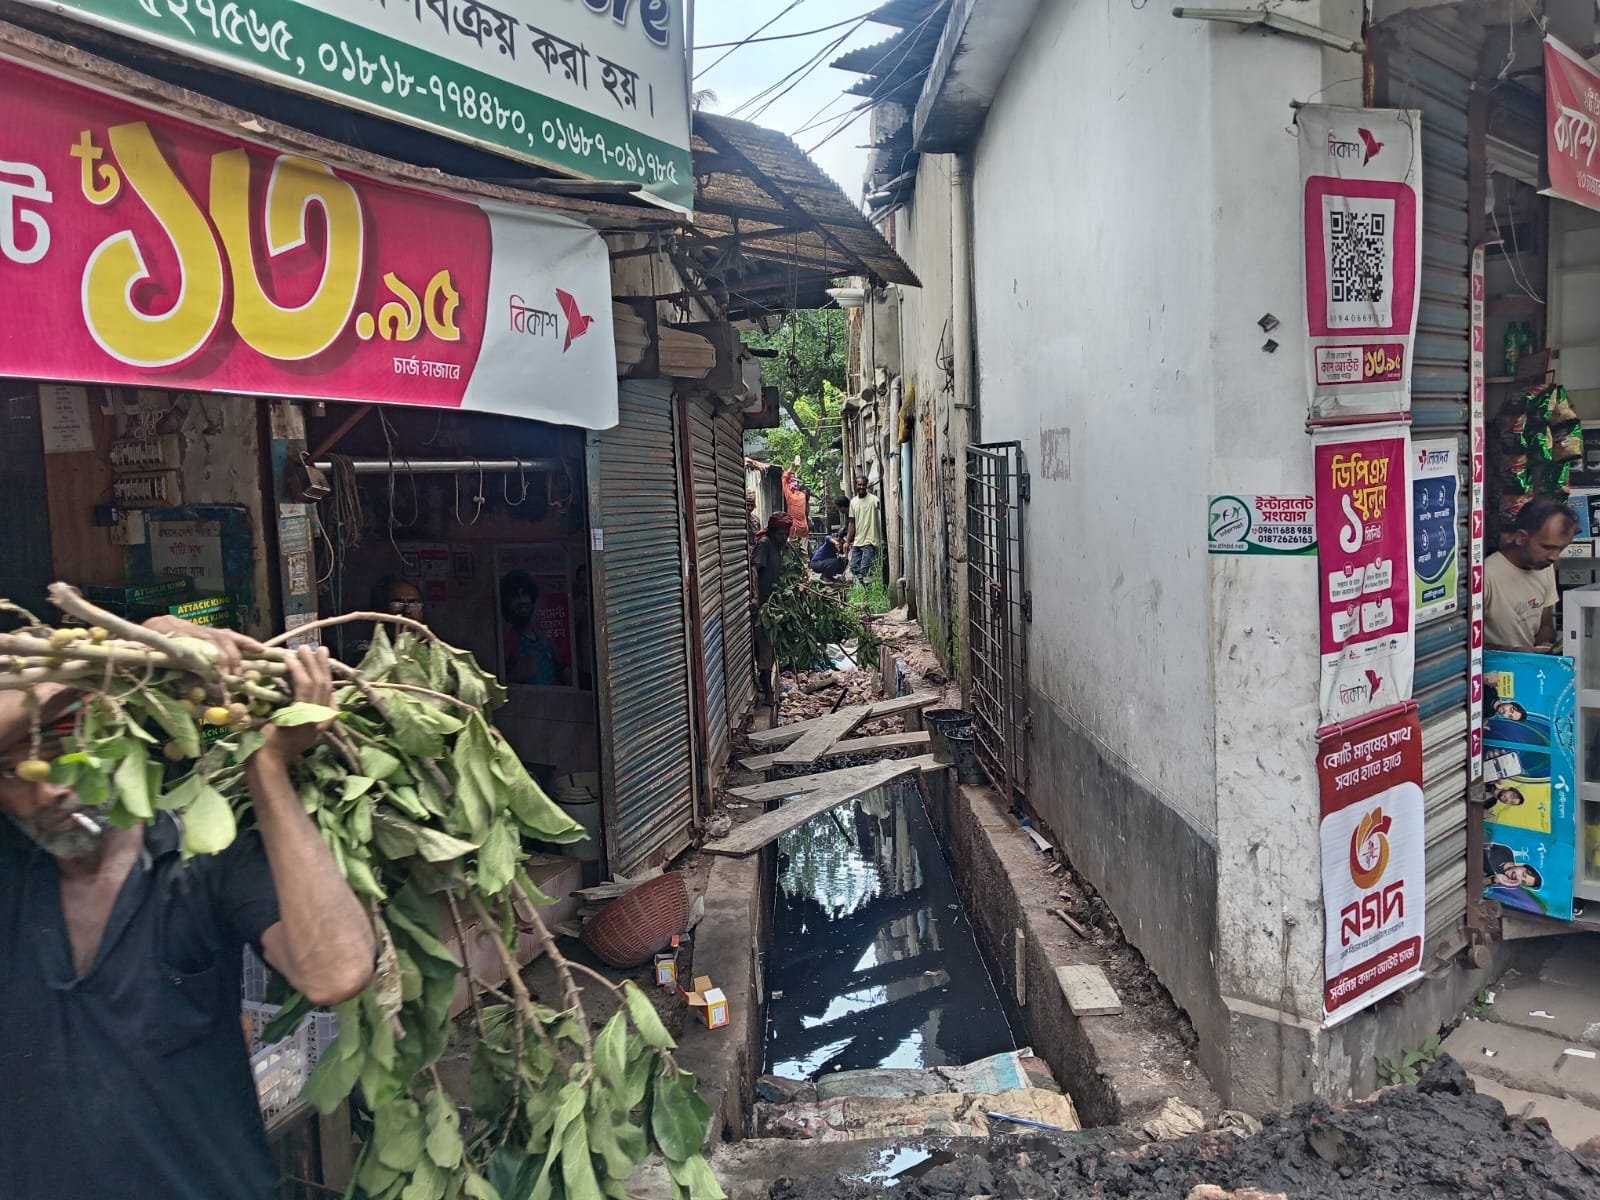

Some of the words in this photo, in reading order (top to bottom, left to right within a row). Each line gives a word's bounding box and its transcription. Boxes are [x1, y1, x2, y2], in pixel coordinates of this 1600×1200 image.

[526, 23, 590, 91] করা
[596, 55, 640, 110] হয়
[1327, 131, 1360, 159] বিকাশ
[509, 293, 559, 340] বিকাশ
[393, 354, 420, 377] চার্জ
[421, 360, 461, 381] হাজারে
[1331, 452, 1389, 490] ডিপিএস
[1255, 495, 1314, 511] ইন্টারনেট
[1262, 511, 1307, 523] সংযোগ
[1352, 485, 1388, 521] খুলুন
[1258, 526, 1279, 535] 09611
[1280, 526, 1296, 535] 688
[1297, 526, 1313, 535] 988
[1258, 535, 1314, 544] 01872626163
[1340, 494, 1364, 554] ১
[177, 599, 211, 615] ATTACK
[210, 596, 231, 606] KING
[188, 613, 210, 625] TACK
[1339, 683, 1368, 705] বিকাশ
[1323, 741, 1353, 769] কোটি
[1353, 733, 1389, 761] মানুষের
[1388, 726, 1412, 747] সাথে
[1335, 768, 1360, 791] সবার
[1360, 759, 1382, 781] হাতে
[1382, 751, 1402, 772] হাতে
[1340, 879, 1404, 947] নগদ
[1329, 976, 1357, 1000] সর্বনিম্ন
[1357, 966, 1377, 985] ক্যাশ
[1376, 952, 1399, 975] আউট
[1399, 941, 1416, 963] চার্জ
